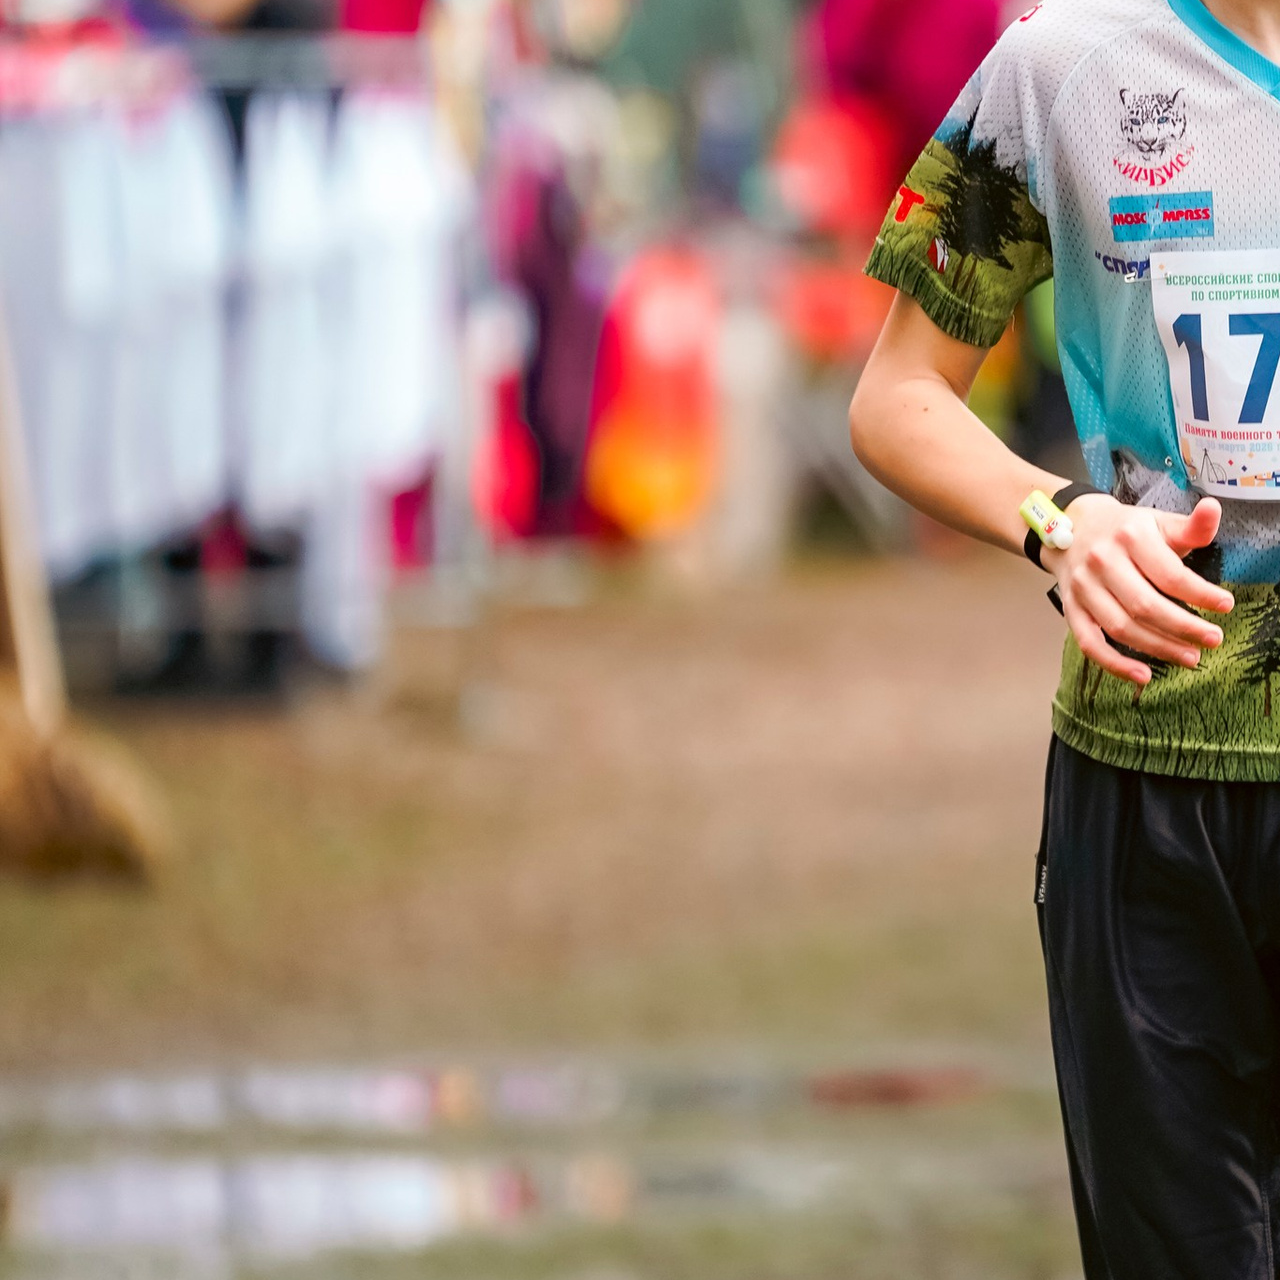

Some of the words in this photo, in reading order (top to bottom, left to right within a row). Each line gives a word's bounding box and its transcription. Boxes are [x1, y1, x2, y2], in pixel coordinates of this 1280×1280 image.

[1166, 273, 1253, 286] ВСЕРОССИЙСКИЕ
[1191, 290, 1204, 301] ПО
[1184, 423, 1218, 439] Памяти
[1221, 430, 1272, 440] военного
